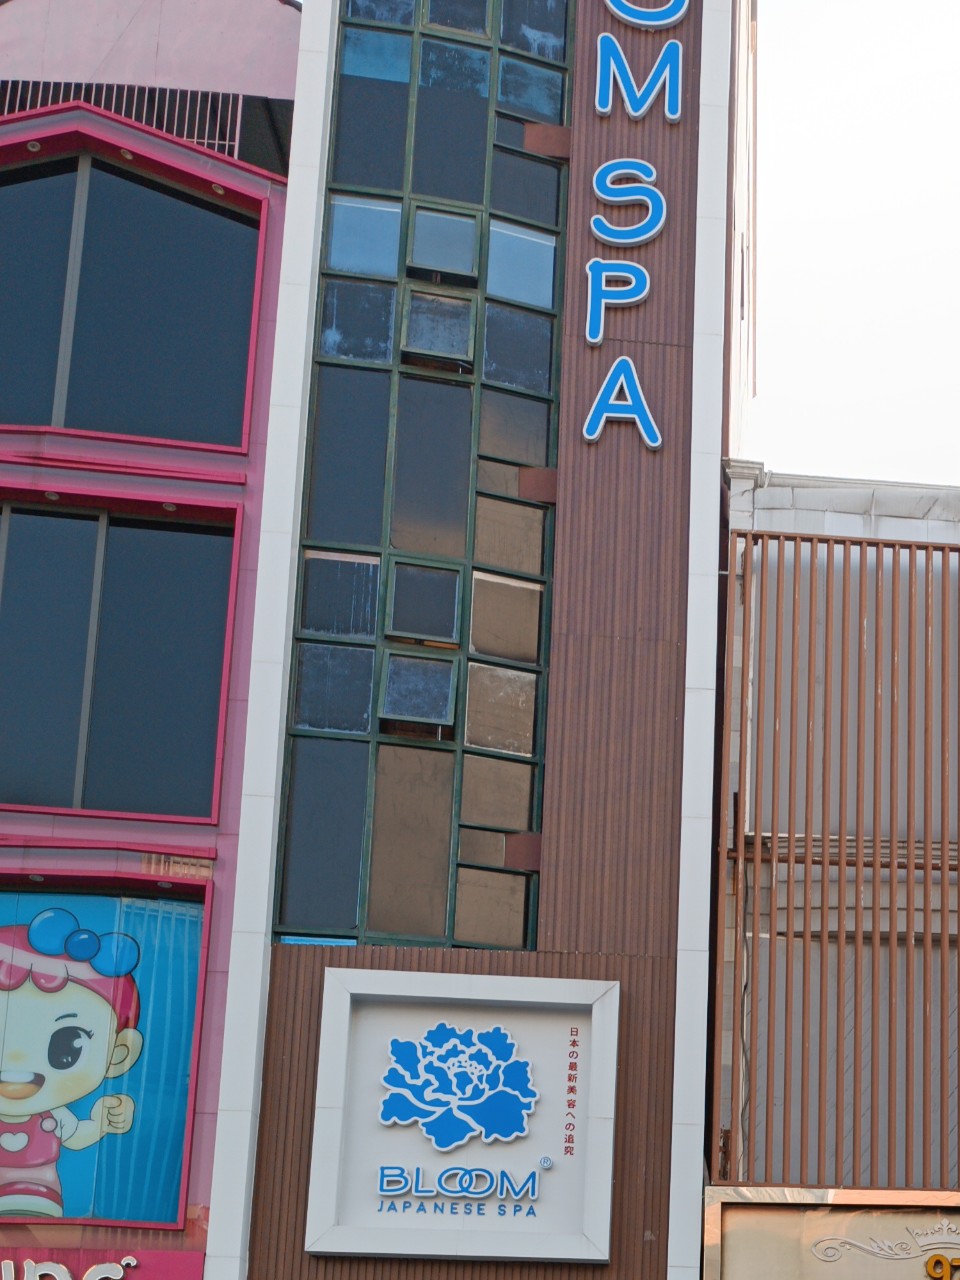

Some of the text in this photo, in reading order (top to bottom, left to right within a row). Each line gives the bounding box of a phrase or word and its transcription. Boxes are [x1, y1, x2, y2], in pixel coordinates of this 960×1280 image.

[582, 158, 668, 450] SPA
[377, 1166, 540, 1201] BLOOM
[377, 1201, 537, 1217] JAPANESE SPA
